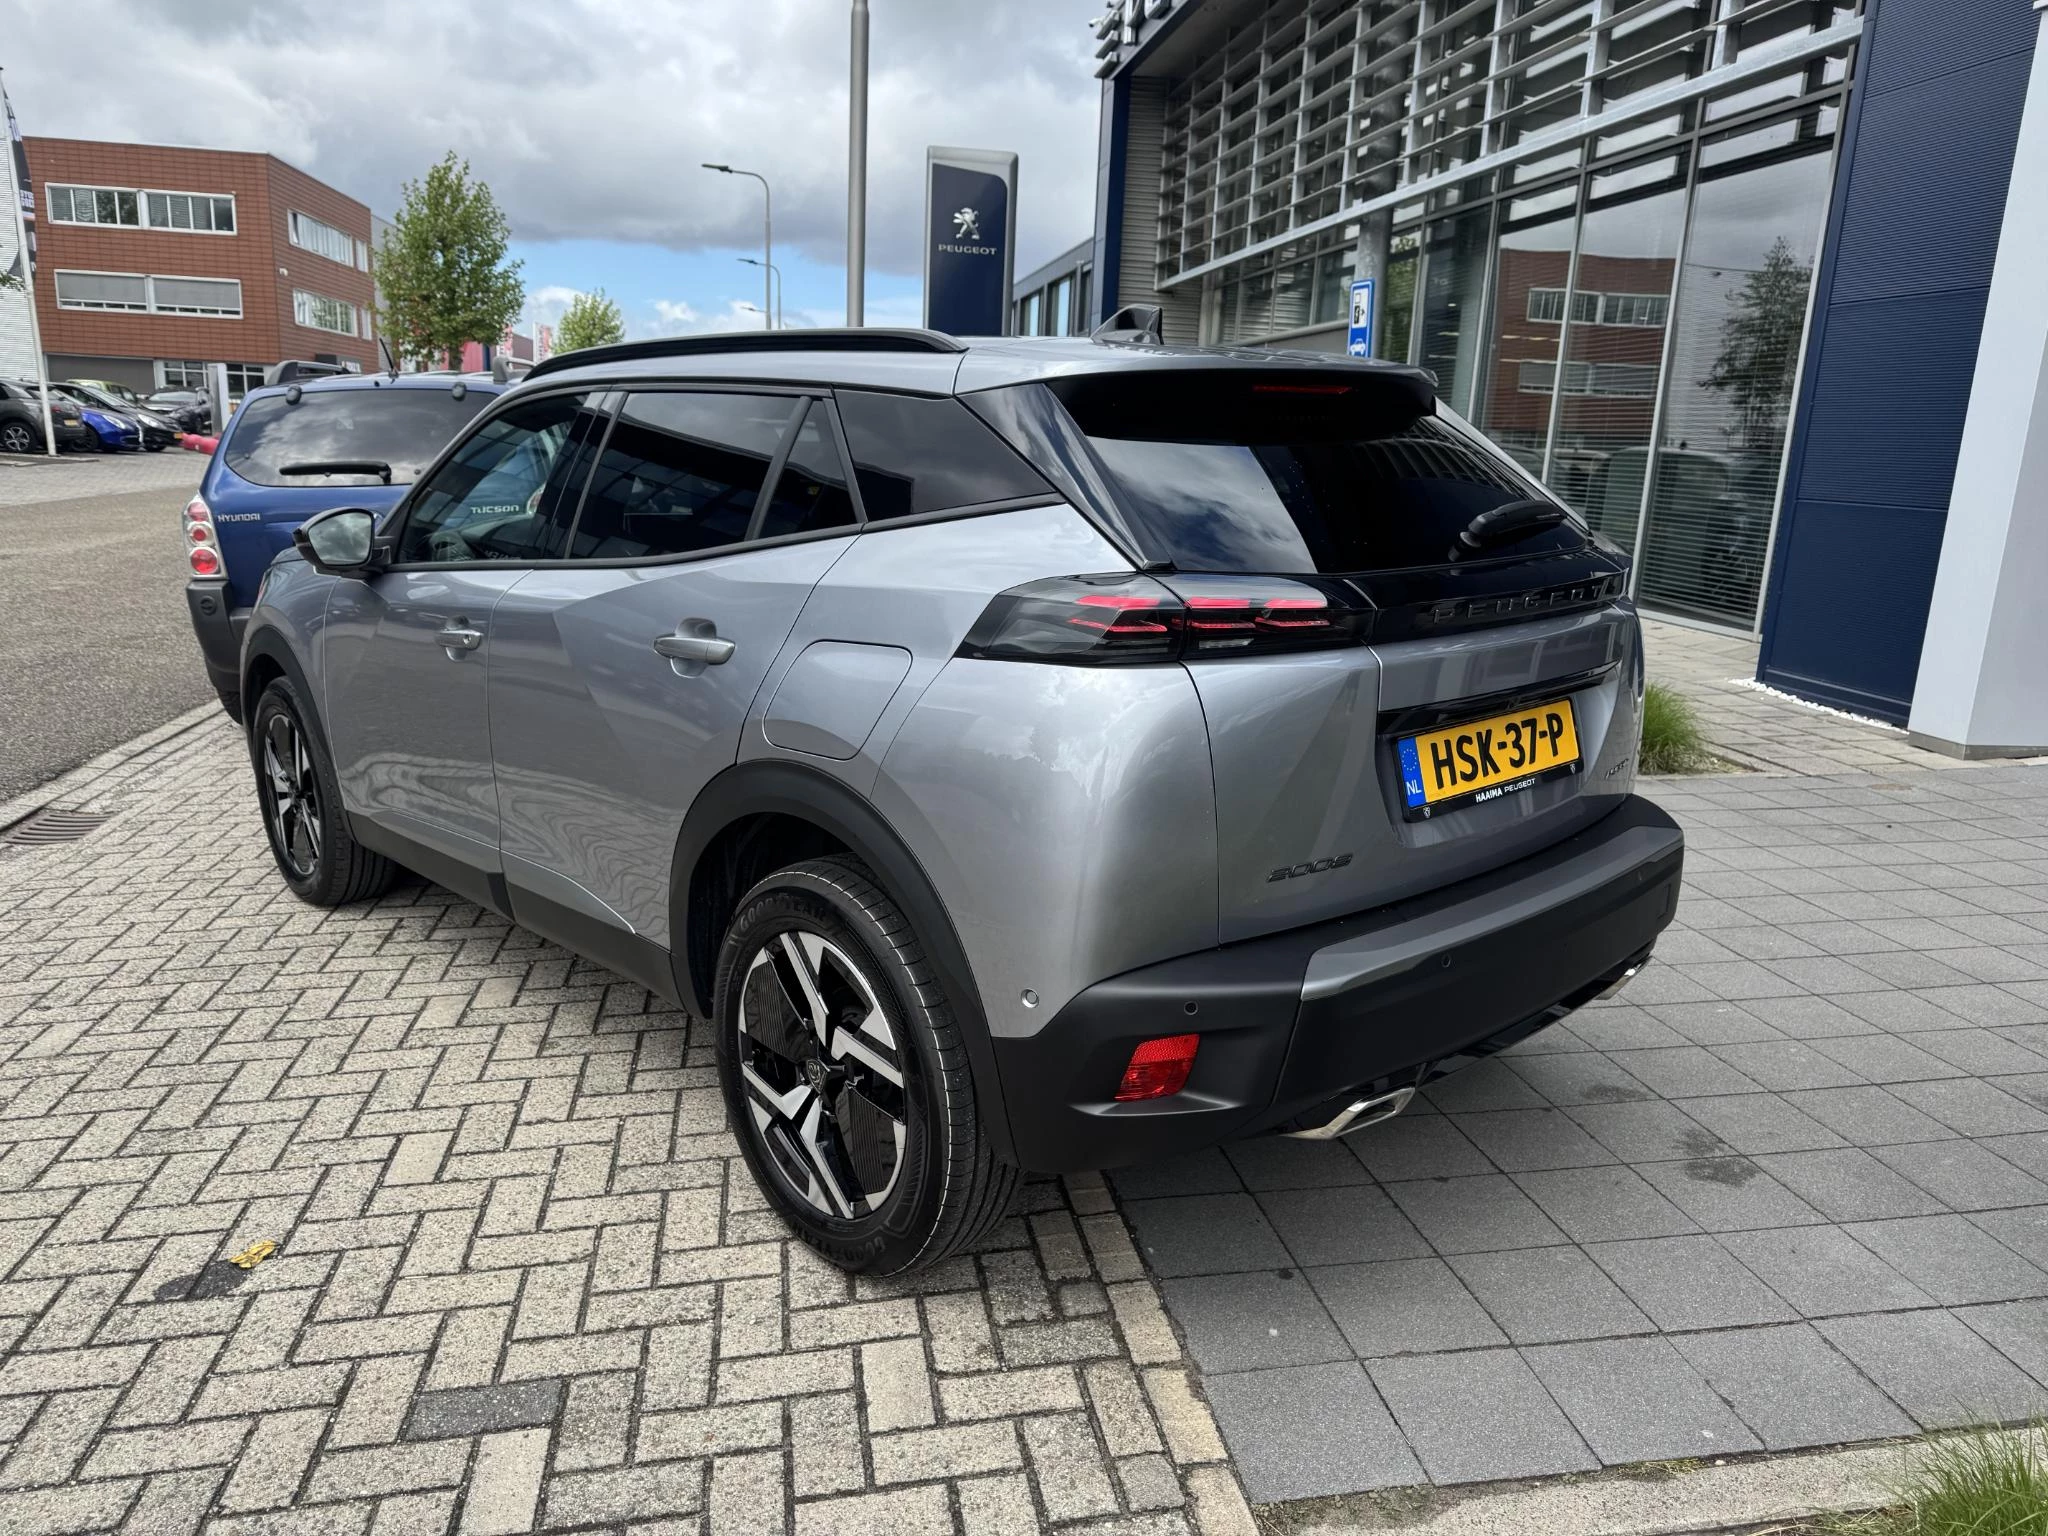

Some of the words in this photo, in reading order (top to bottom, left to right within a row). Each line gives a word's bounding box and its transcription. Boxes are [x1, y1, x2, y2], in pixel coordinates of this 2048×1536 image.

[938, 244, 997, 256] PEUGEOT
[470, 504, 520, 514] TUCSON
[217, 513, 261, 522] HYUNDAI
[1430, 712, 1564, 790] HSK-37-P
[1405, 780, 1423, 796] NL
[1475, 787, 1503, 803] HAAIMA
[1503, 777, 1536, 793] PEUGEOT
[1266, 854, 1353, 883] 2008
